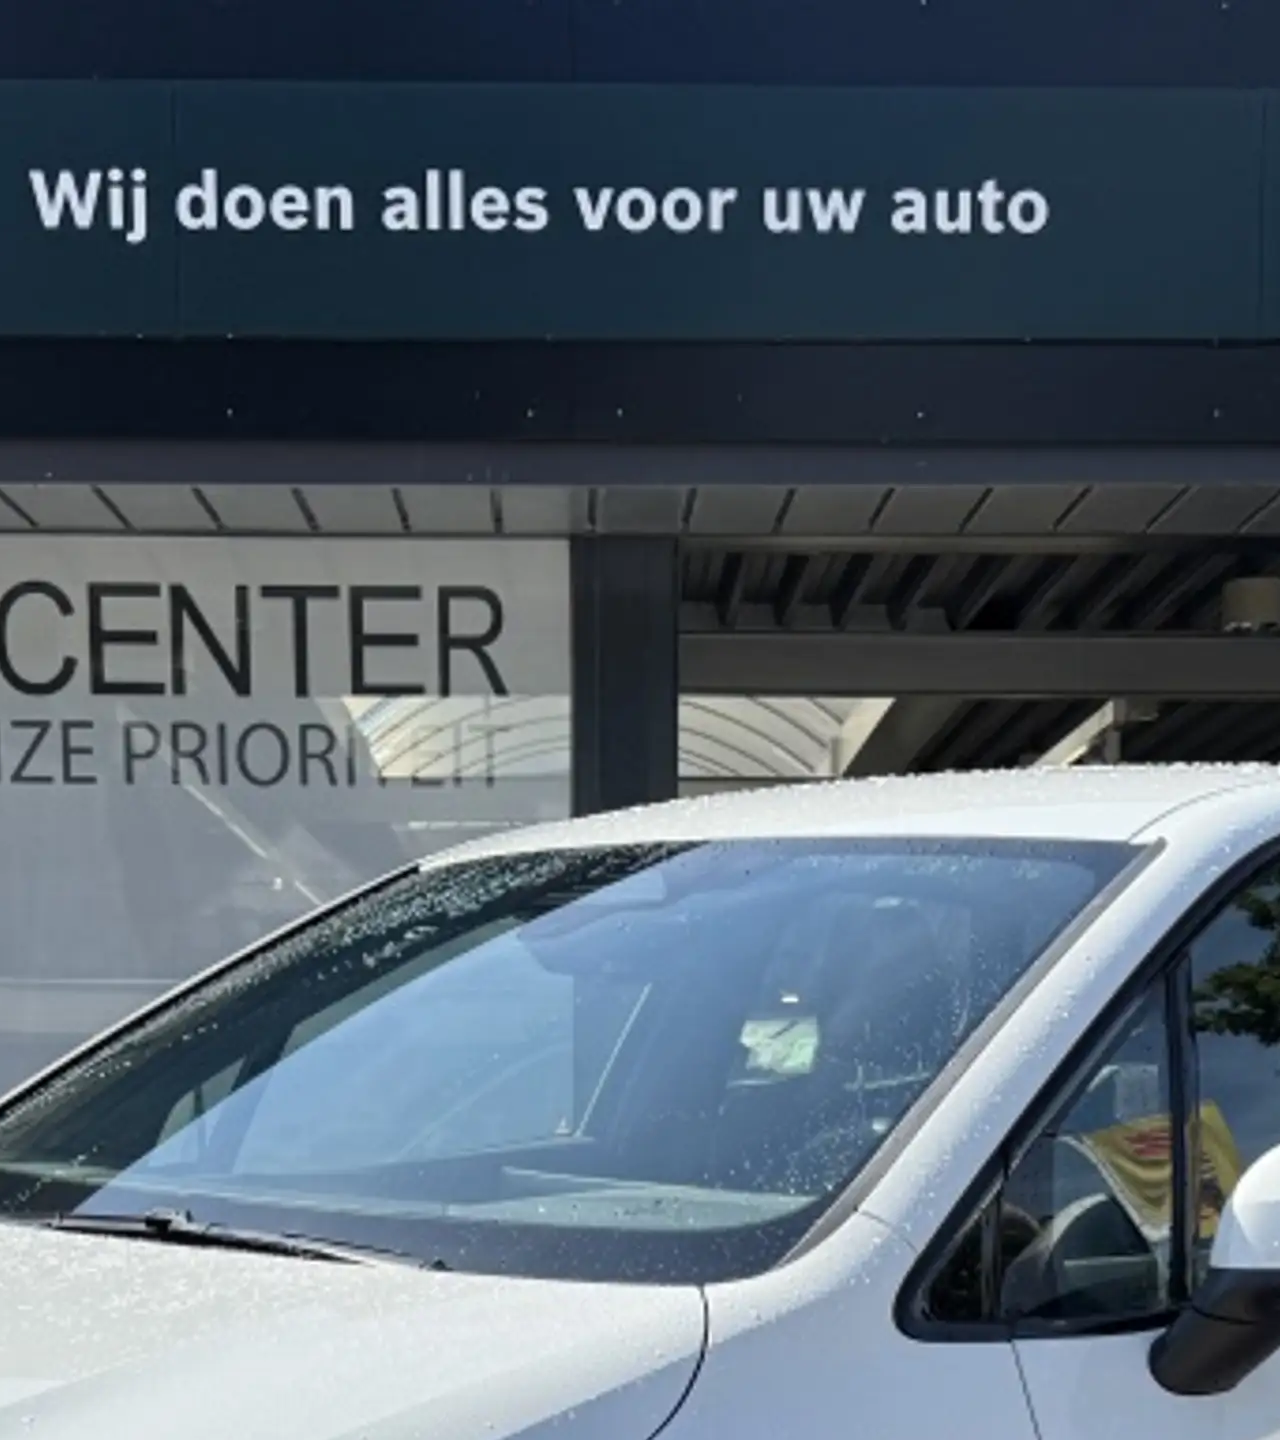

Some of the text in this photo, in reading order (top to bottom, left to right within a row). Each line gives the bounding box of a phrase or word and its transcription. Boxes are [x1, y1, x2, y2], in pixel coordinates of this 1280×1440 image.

[28, 167, 1050, 245] Wij doen alles voor uw auto
[123, 719, 511, 788] PRIORIEIT
